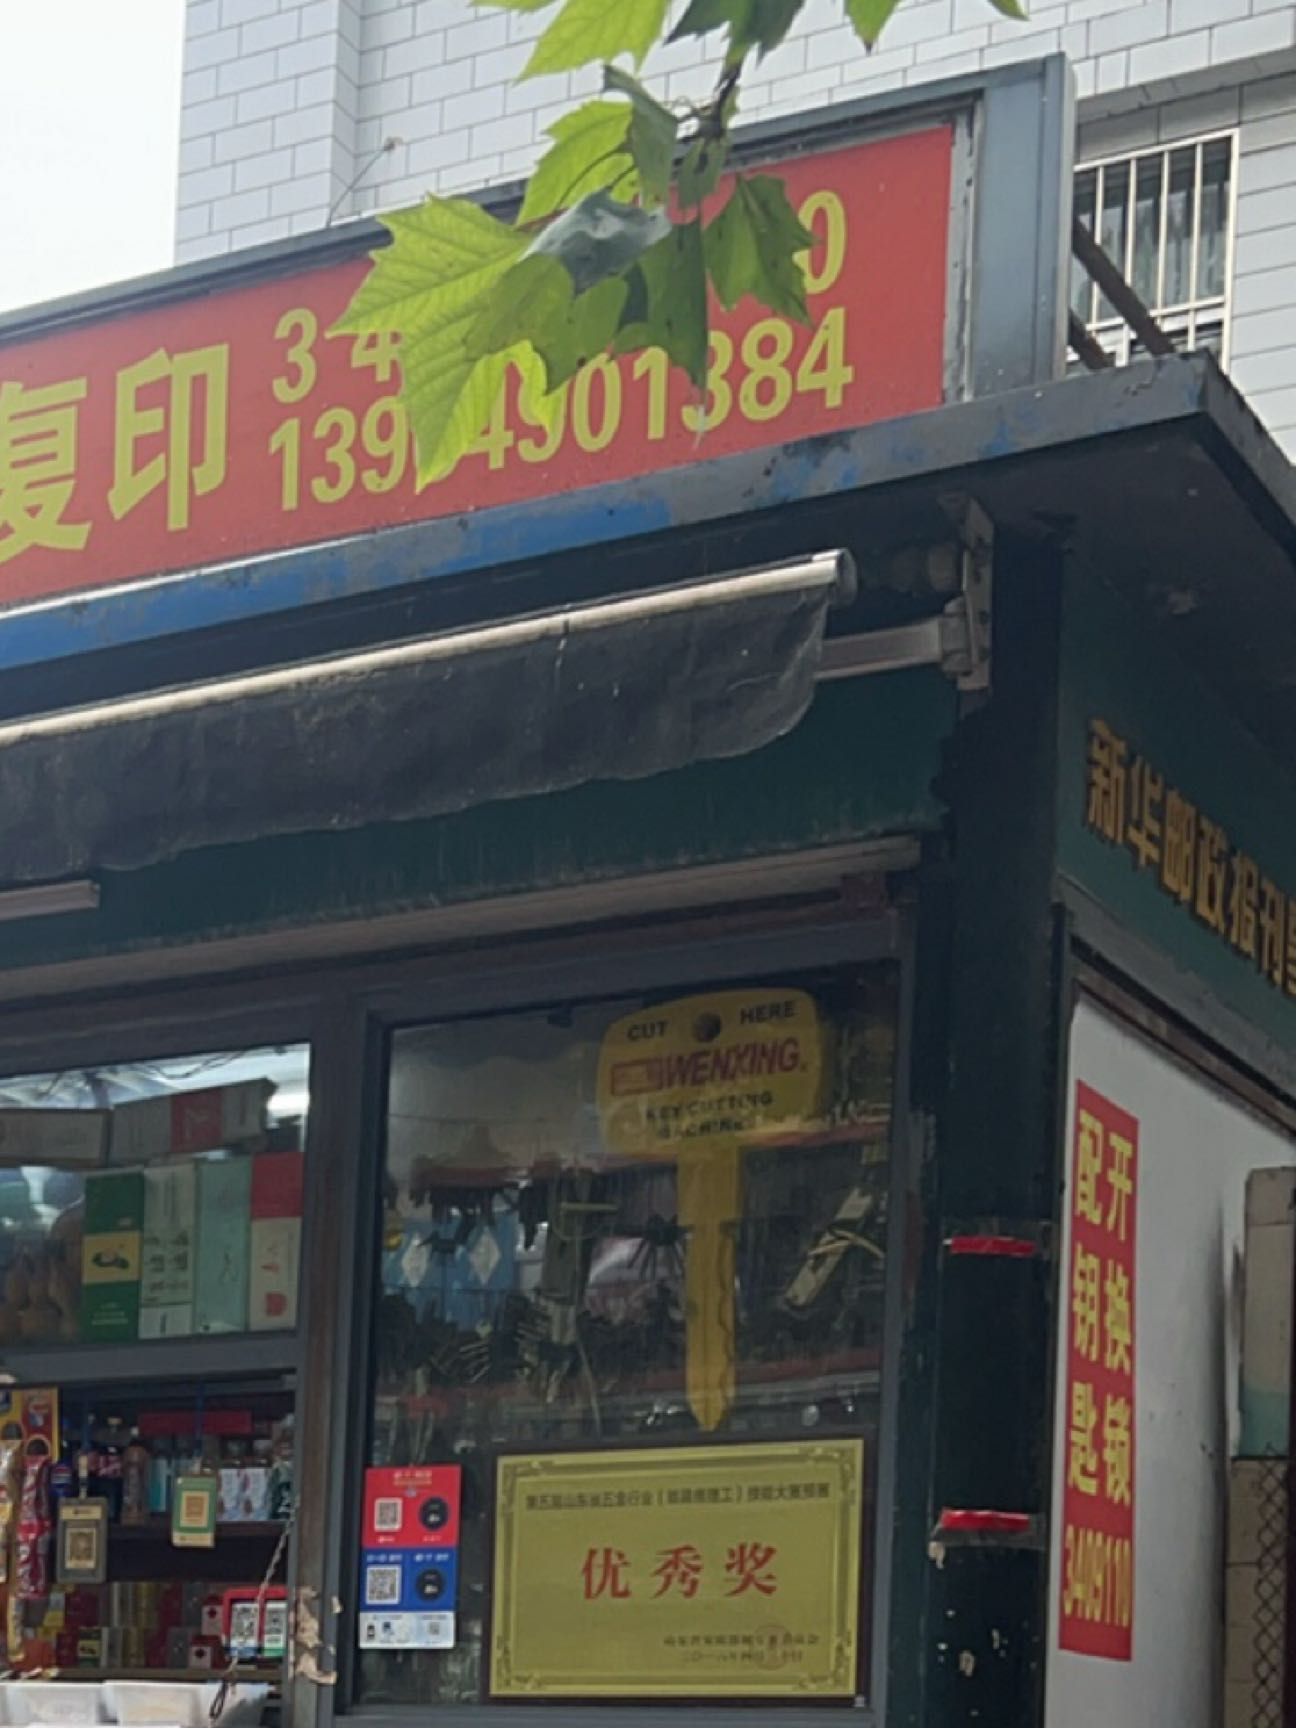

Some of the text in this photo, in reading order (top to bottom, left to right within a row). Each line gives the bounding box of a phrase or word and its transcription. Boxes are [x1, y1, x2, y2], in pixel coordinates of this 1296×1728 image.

[268, 307, 854, 511] 1394901384
[627, 1000, 796, 1041] CUT HERE
[580, 1541, 779, 1601] 优秀奖
